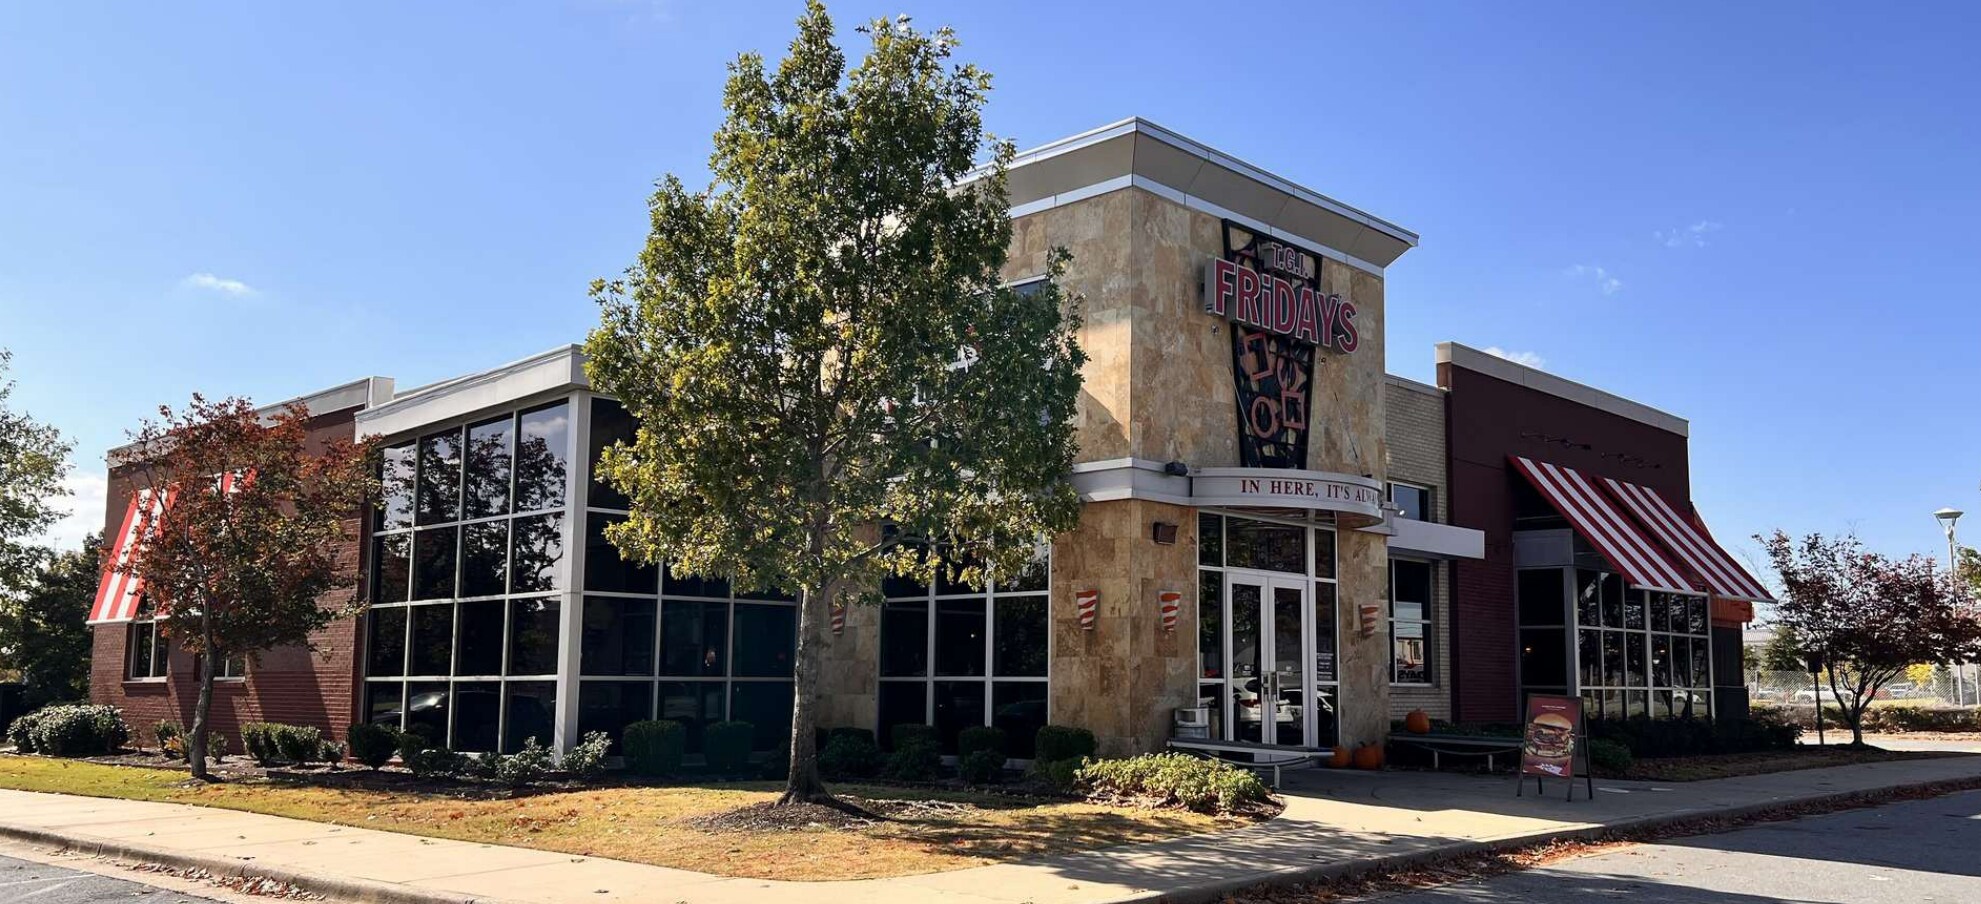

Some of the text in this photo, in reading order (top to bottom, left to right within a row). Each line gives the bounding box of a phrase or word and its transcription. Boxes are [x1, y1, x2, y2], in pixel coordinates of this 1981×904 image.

[1271, 242, 1310, 279] T.G.I.
[1241, 479, 1261, 494] IN
[1270, 480, 1319, 498] HERE,
[1327, 484, 1351, 500] IT'S
